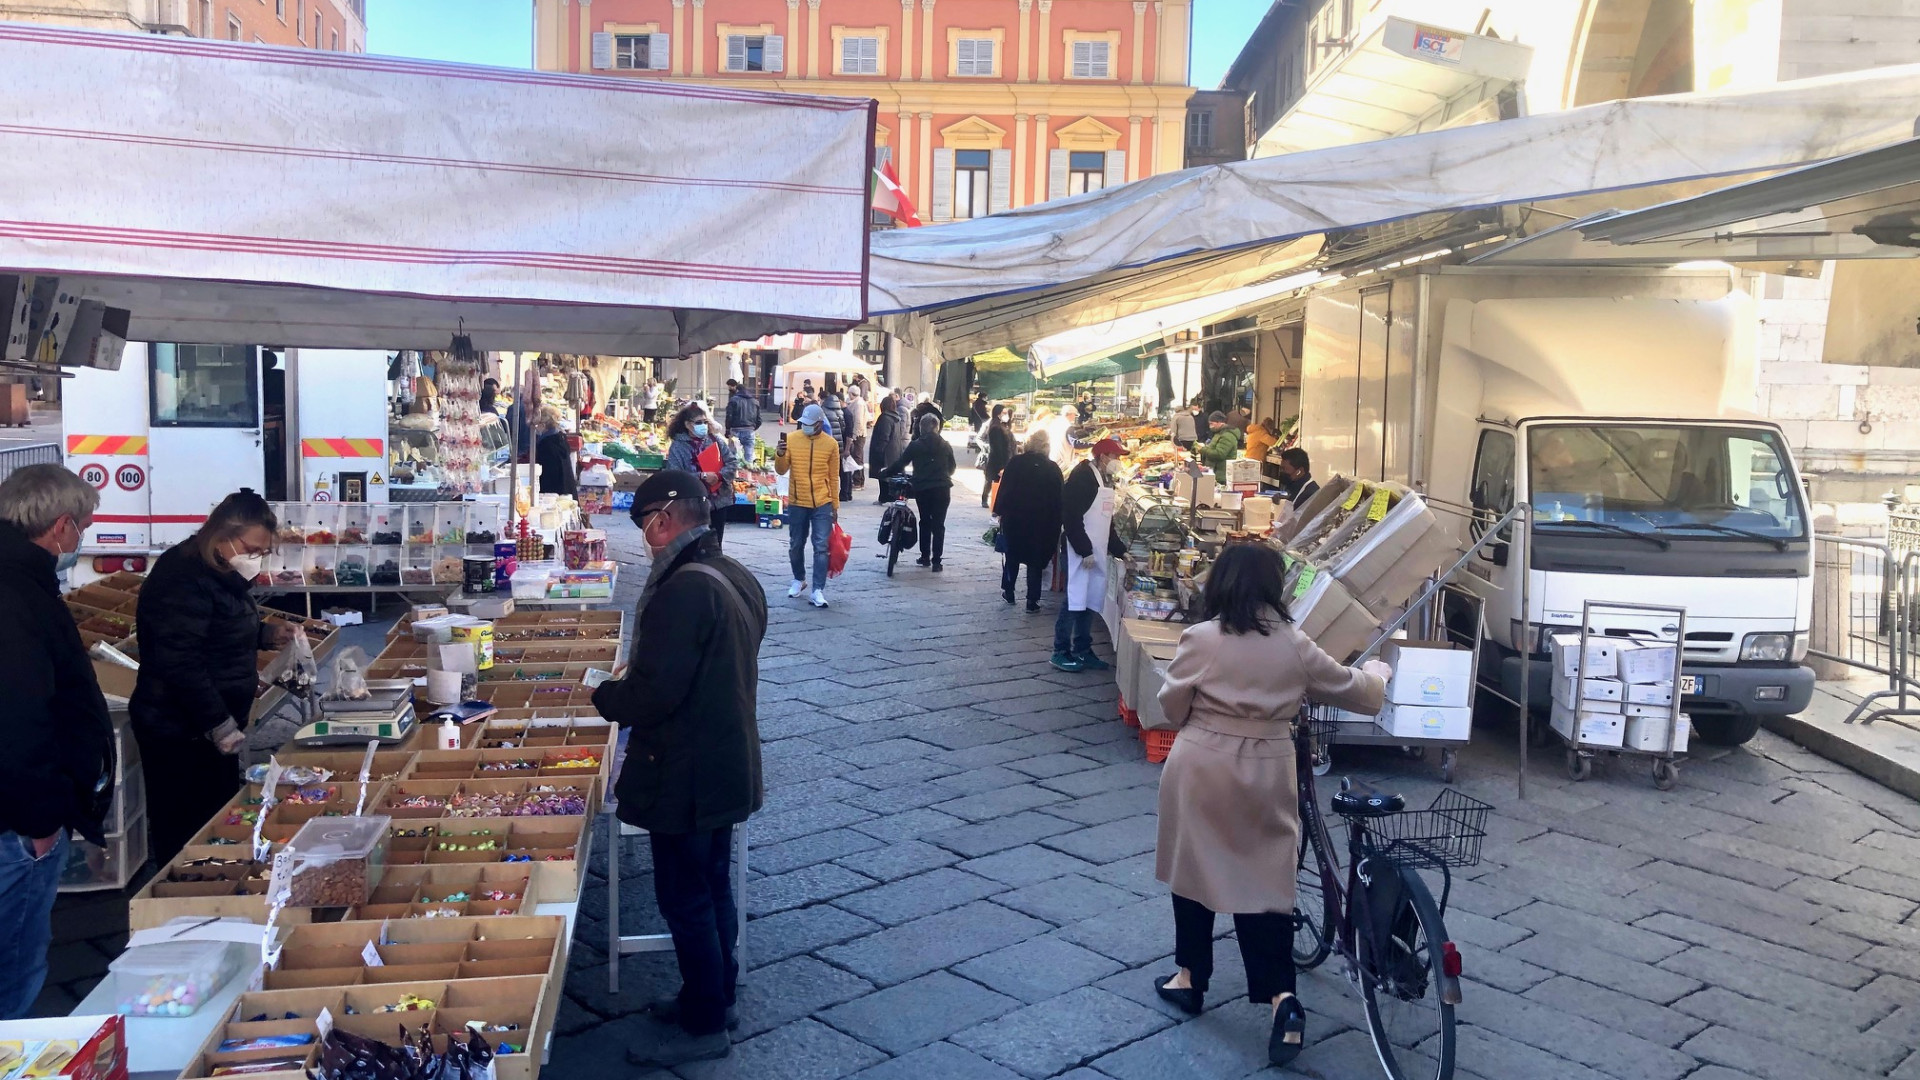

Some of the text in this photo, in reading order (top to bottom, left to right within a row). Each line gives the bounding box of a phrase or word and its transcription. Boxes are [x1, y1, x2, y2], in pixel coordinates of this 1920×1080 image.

[87, 471, 102, 482] 80
[121, 472, 140, 484] 100
[1694, 684, 1703, 692] PR
